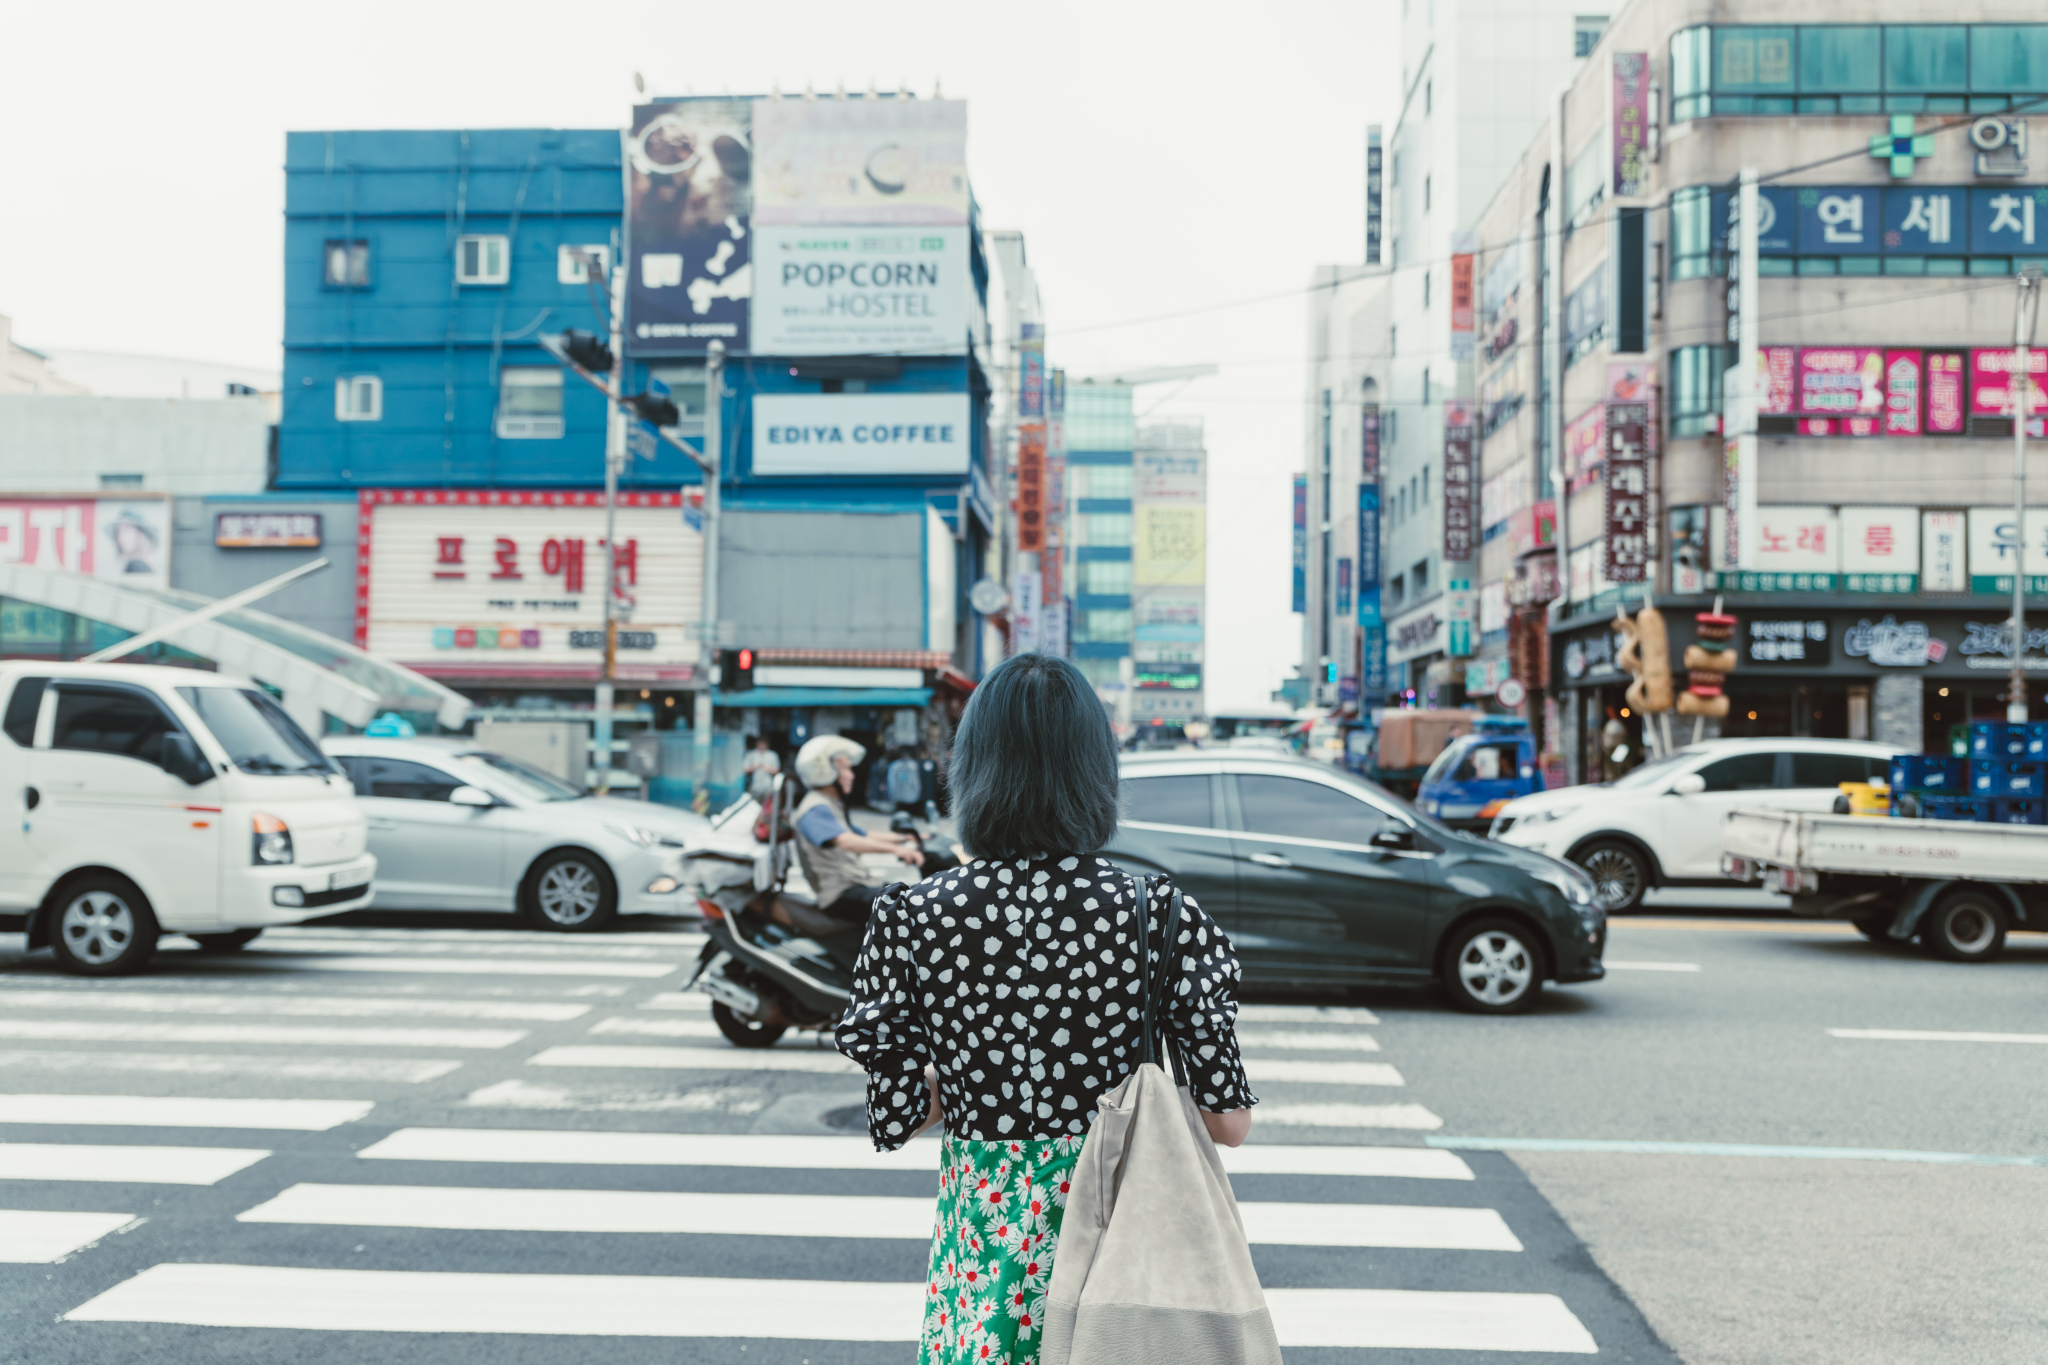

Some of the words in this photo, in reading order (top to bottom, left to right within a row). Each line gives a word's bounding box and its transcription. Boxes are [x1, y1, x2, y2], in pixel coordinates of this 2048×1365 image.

[1818, 194, 2036, 244] 연세치
[782, 263, 938, 287] POPCORN
[827, 292, 936, 317] HOSTEL
[768, 425, 844, 443] EDIYA
[853, 425, 954, 443] COFFEE
[1760, 525, 1826, 555] 노래
